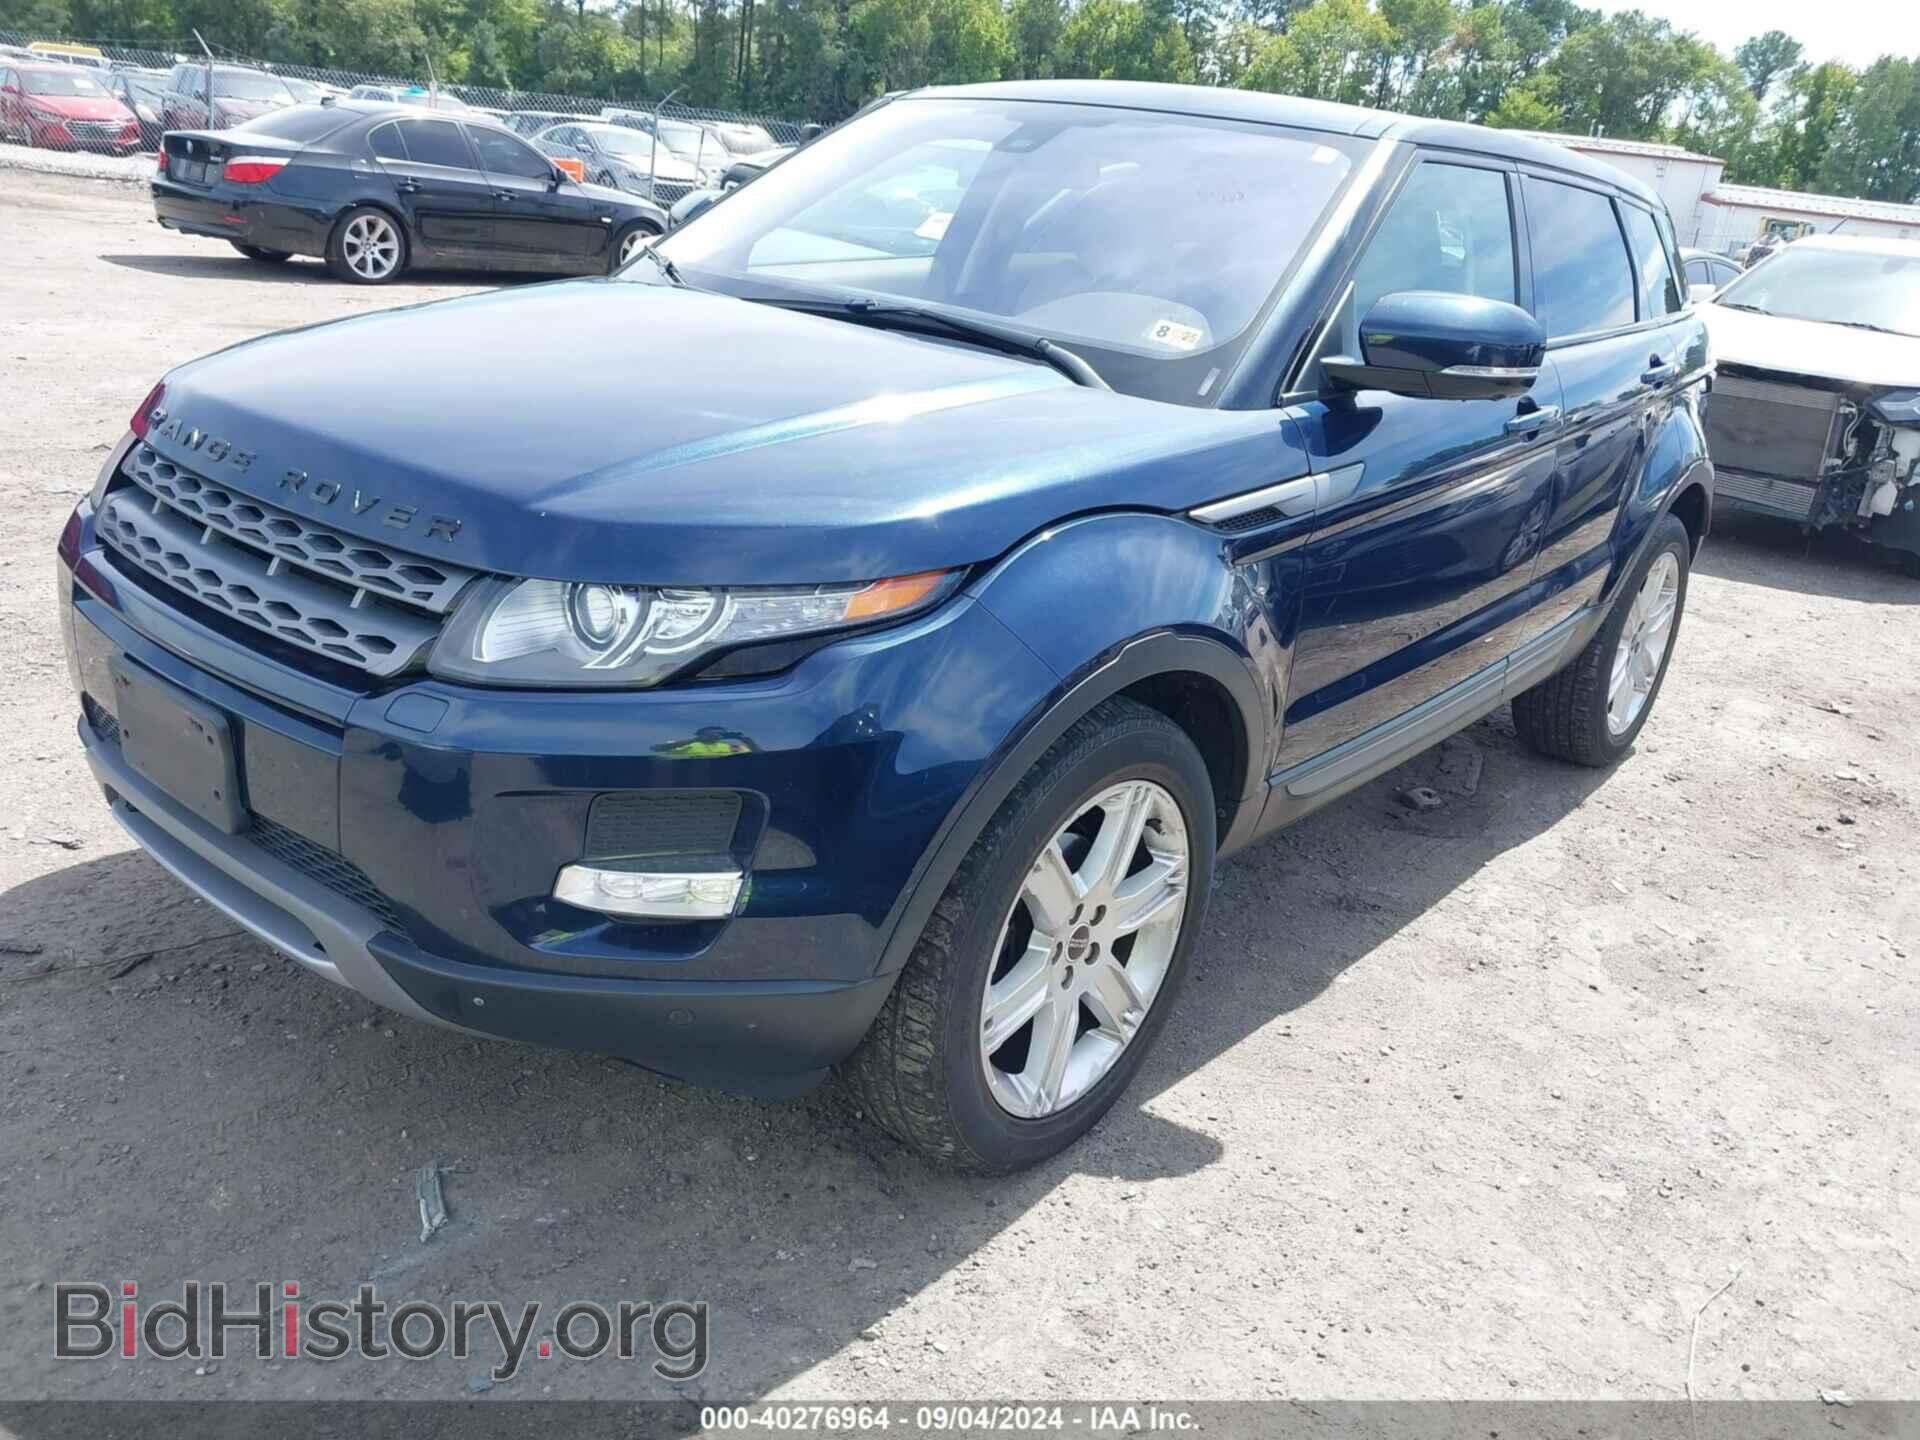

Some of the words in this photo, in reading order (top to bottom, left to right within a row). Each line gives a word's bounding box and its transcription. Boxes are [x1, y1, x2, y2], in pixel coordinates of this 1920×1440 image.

[1156, 325, 1170, 338] 8
[148, 406, 257, 473] RANGE
[277, 468, 462, 542] ROVER
